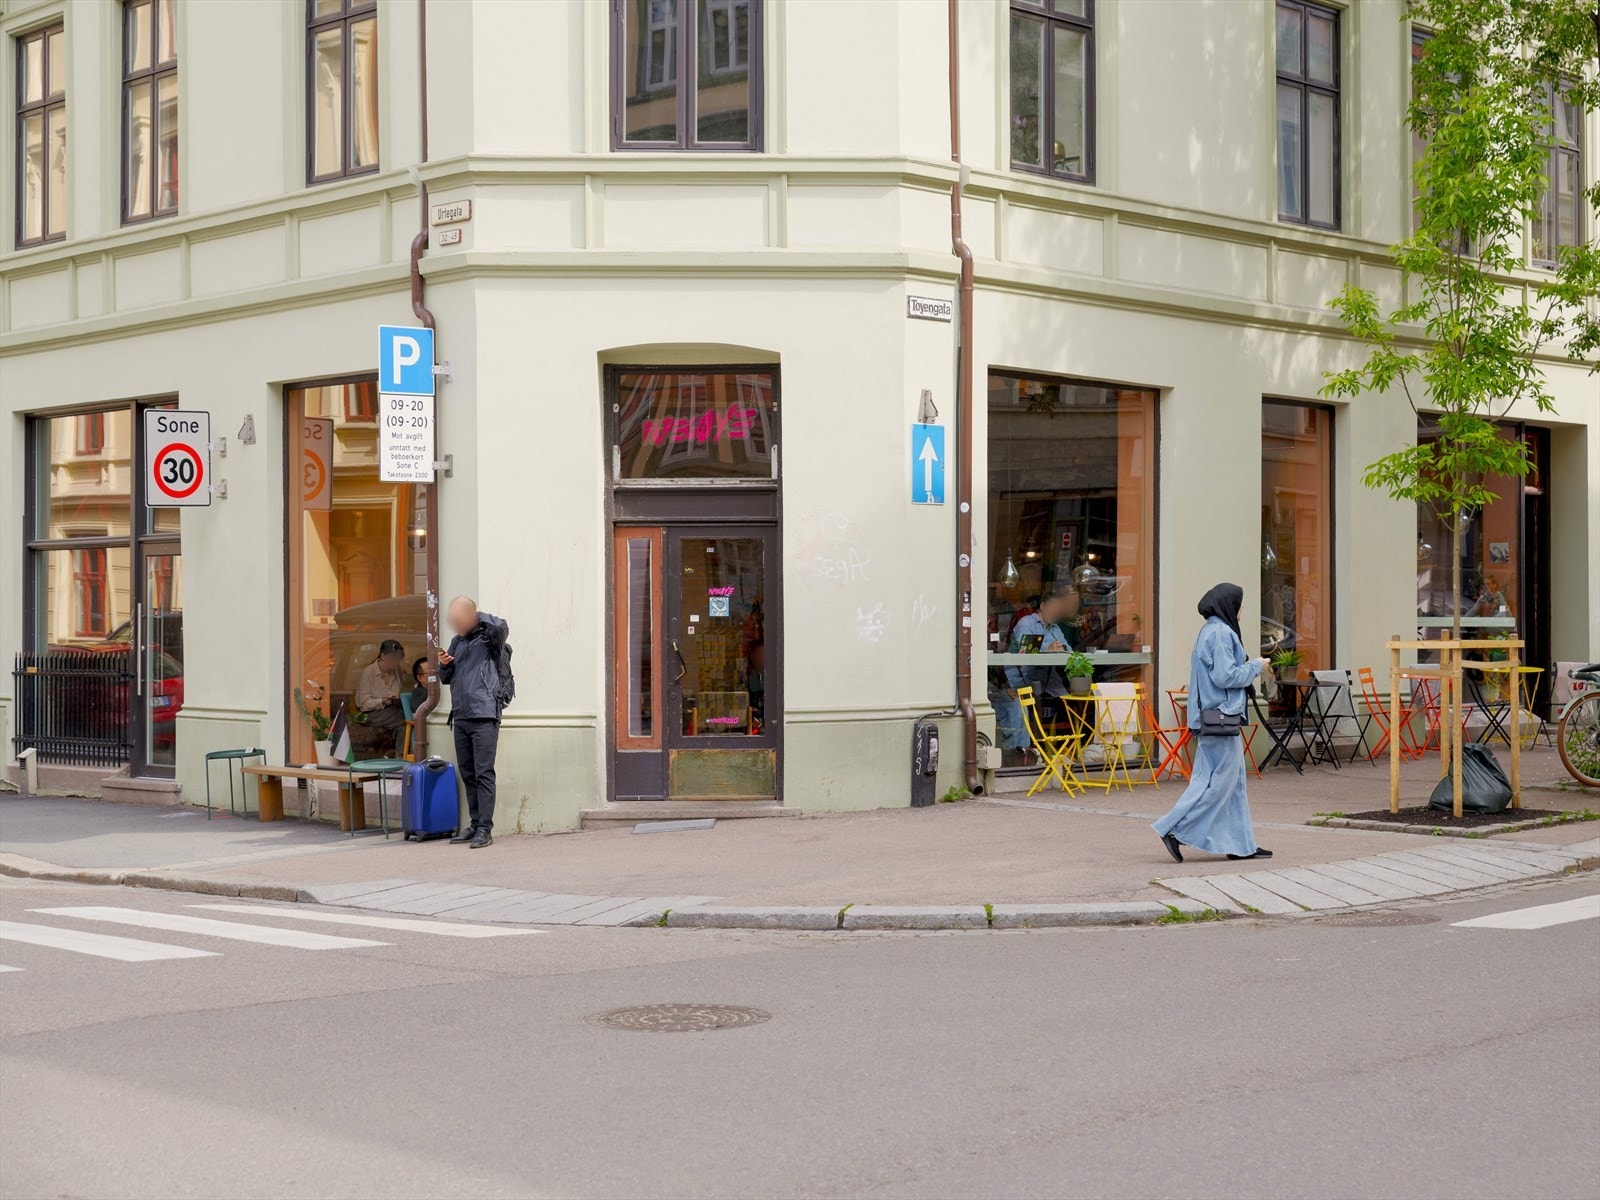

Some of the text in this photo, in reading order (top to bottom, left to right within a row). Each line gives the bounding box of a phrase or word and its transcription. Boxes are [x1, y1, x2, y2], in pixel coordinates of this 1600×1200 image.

[437, 205, 463, 221] Urtegata
[392, 335, 421, 385] P
[157, 416, 199, 434] Sone
[391, 432, 423, 442] Mot avgift
[388, 444, 411, 452] unntatt
[390, 453, 424, 461] beboerkort
[163, 457, 195, 484] 30
